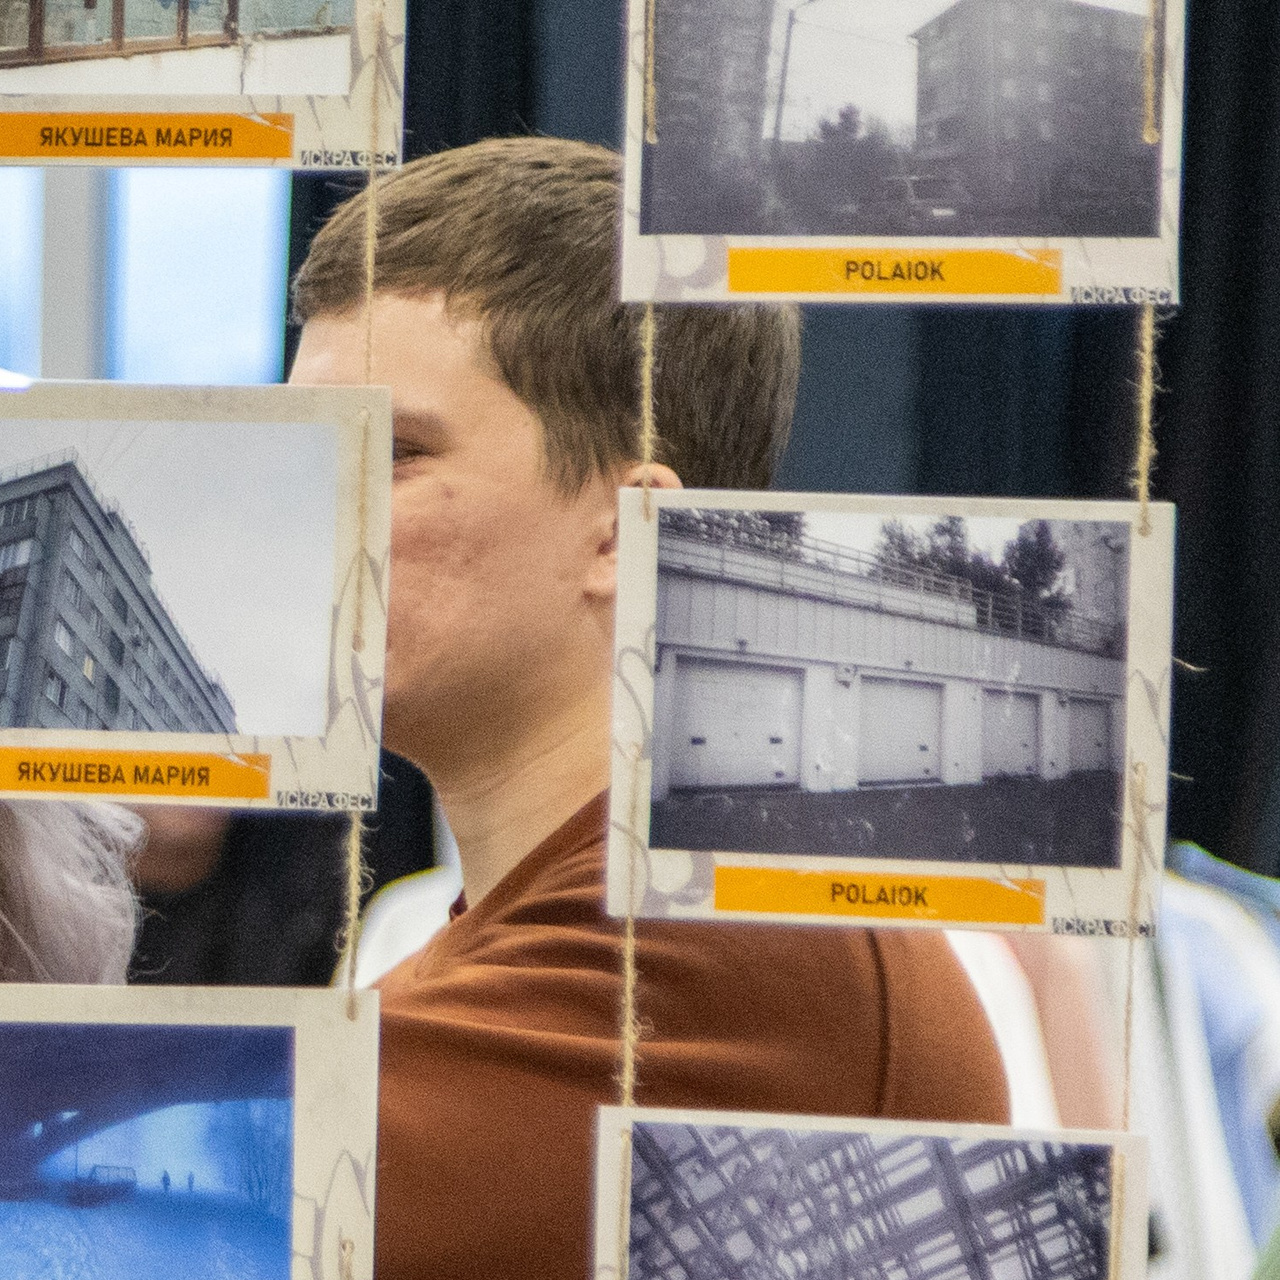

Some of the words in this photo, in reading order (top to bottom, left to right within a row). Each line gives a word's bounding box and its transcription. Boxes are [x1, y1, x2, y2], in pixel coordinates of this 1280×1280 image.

[39, 126, 148, 147] ЯКУШЕВА
[155, 127, 233, 147] МАРИЯ
[845, 260, 945, 281] POLAIOK
[17, 761, 126, 784] ЯКУШЕВА
[133, 764, 210, 787] МАРИЯ
[276, 790, 329, 809] ИСКРА
[830, 882, 929, 907] POLAIOK
